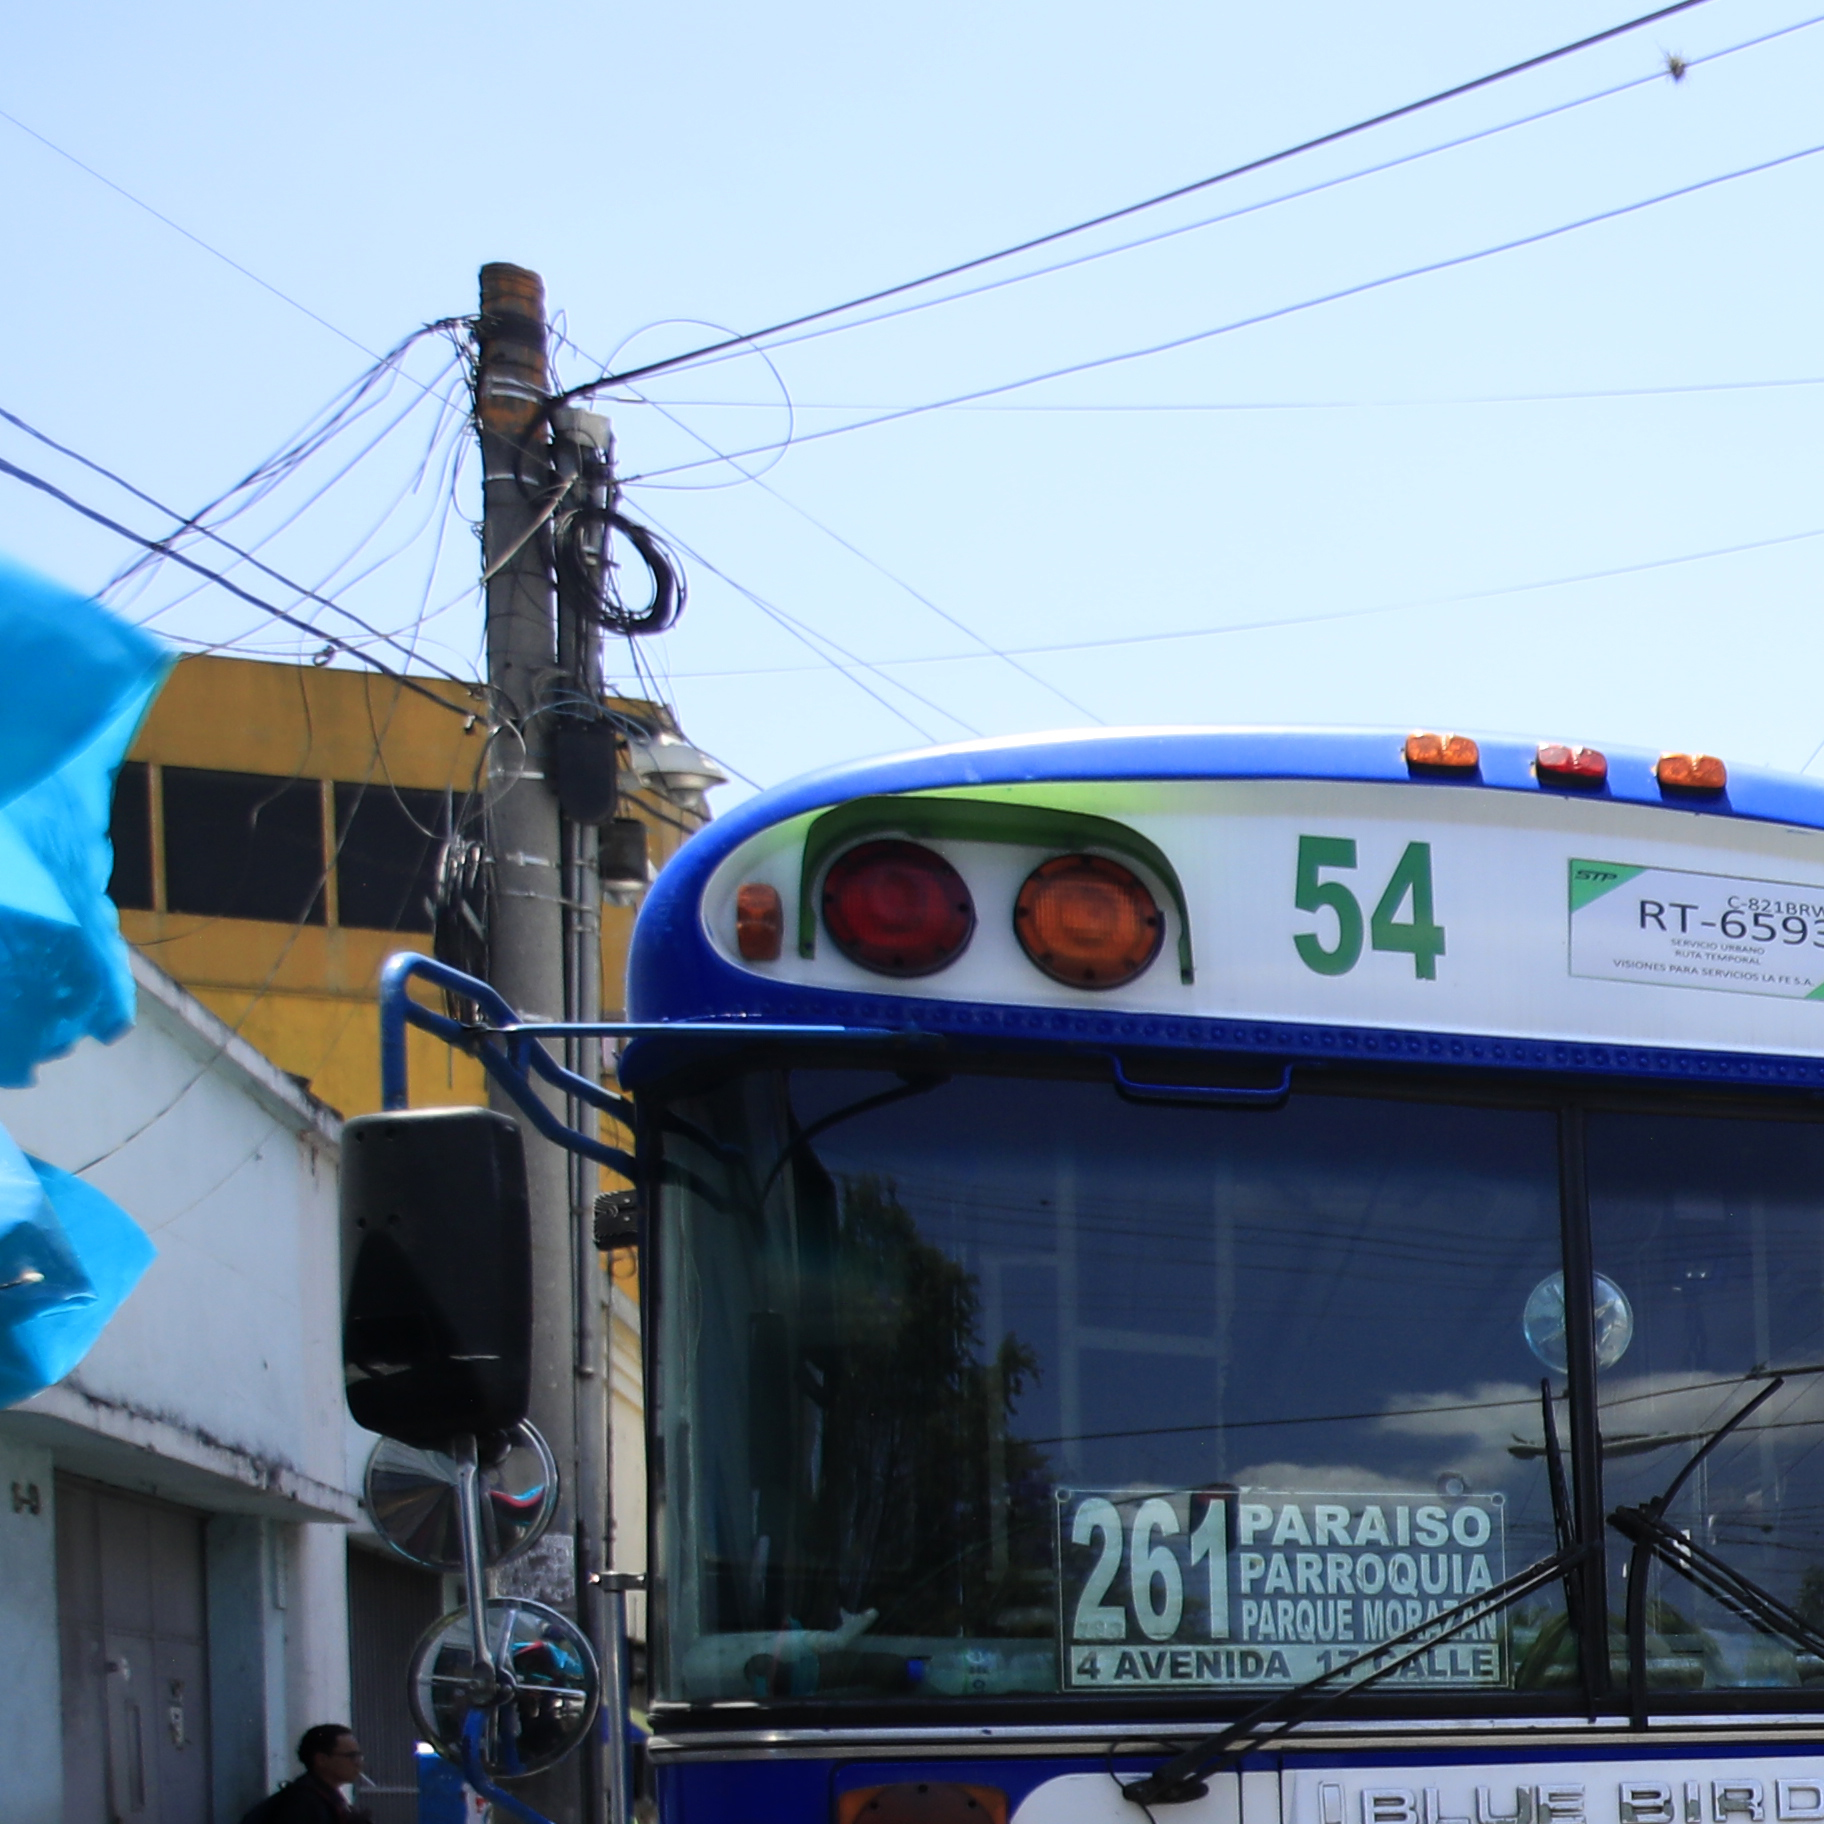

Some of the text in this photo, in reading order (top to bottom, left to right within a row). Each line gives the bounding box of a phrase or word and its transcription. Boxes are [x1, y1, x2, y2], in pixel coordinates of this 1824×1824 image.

[1293, 834, 1446, 981] 54
[1670, 938, 1765, 956] SERVICIO URBANO
[1675, 950, 1762, 966] RUTA TEMPORAL
[1613, 958, 1667, 972] VISIONES
[1669, 964, 1699, 976] PARA
[1701, 967, 1760, 982] SERVICIOS
[1762, 973, 1775, 983] LA
[1778, 975, 1791, 985] FE
[1239, 1504, 1491, 1548] PARAISO
[1072, 1497, 1229, 1641] 261
[1240, 1552, 1496, 1597] PARROQUIA
[1242, 1599, 1497, 1644] PARQUE MORAZAN
[1077, 1649, 1495, 1680] 4 AVENIDA 17 CALLE
